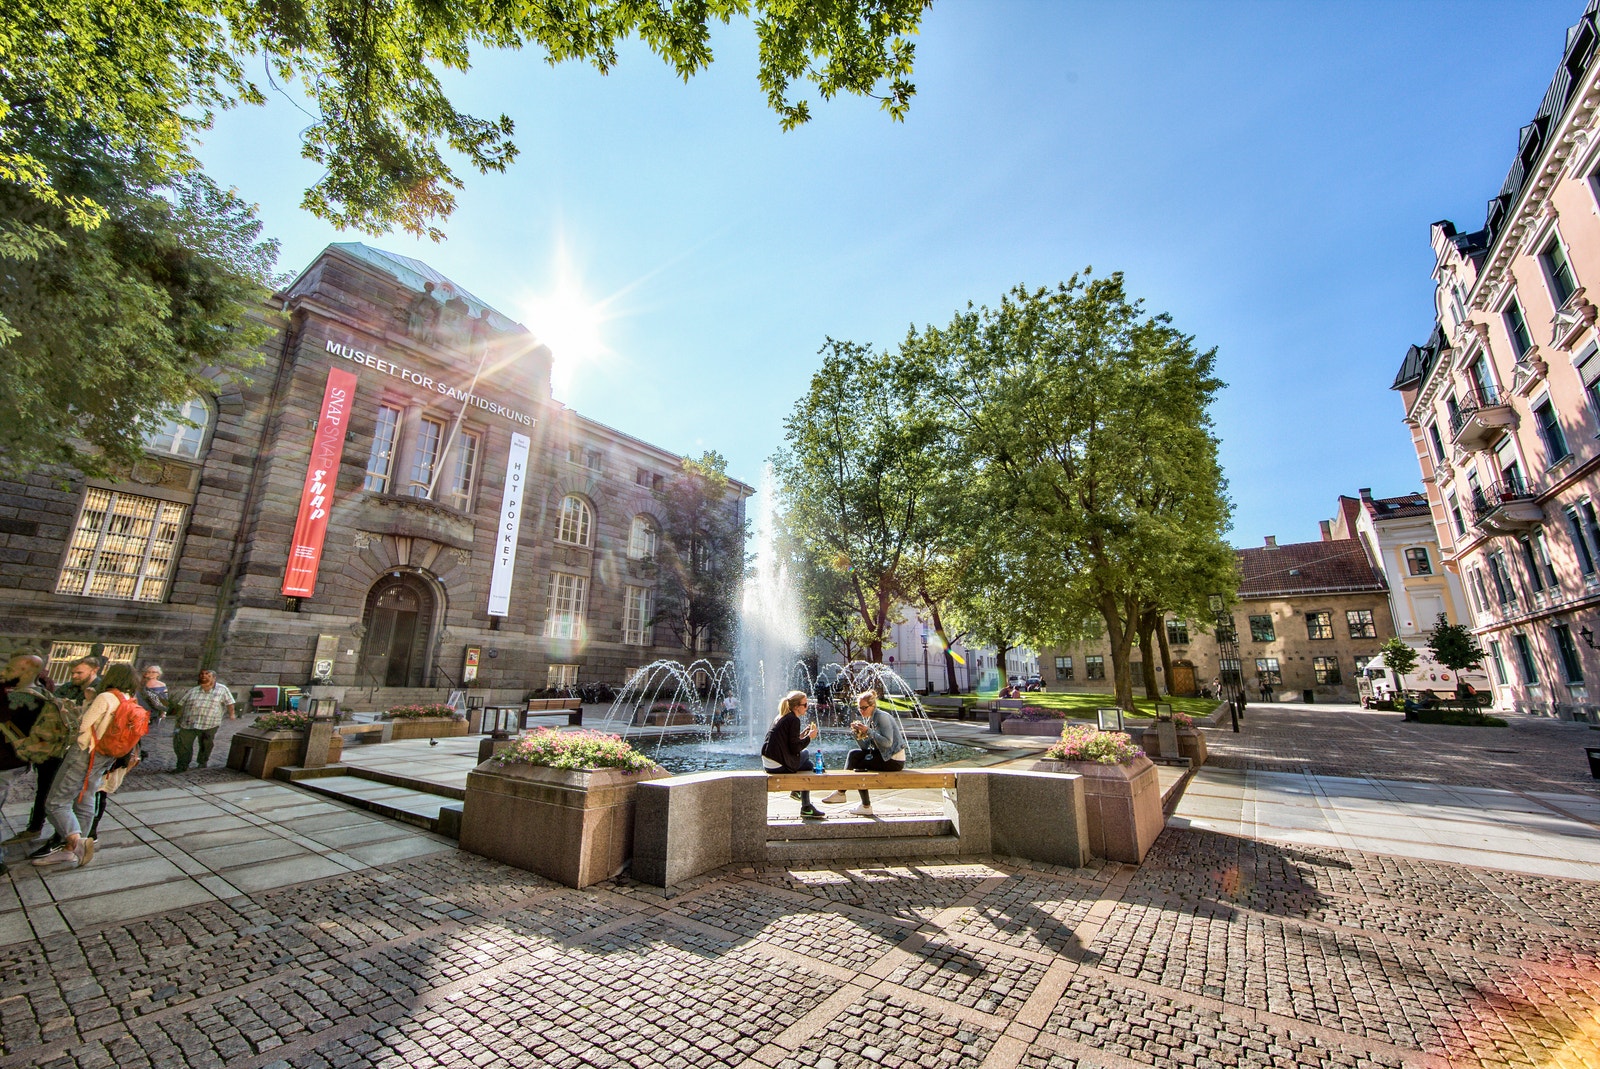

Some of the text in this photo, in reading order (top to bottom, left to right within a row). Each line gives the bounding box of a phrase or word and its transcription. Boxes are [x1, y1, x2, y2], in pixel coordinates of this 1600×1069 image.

[325, 340, 539, 428] MUSEET FOR SAMTIDSKUNST
[310, 387, 346, 521] SNAP SNAP SNAP
[511, 462, 521, 492] HOT
[502, 500, 516, 567] POCKET
